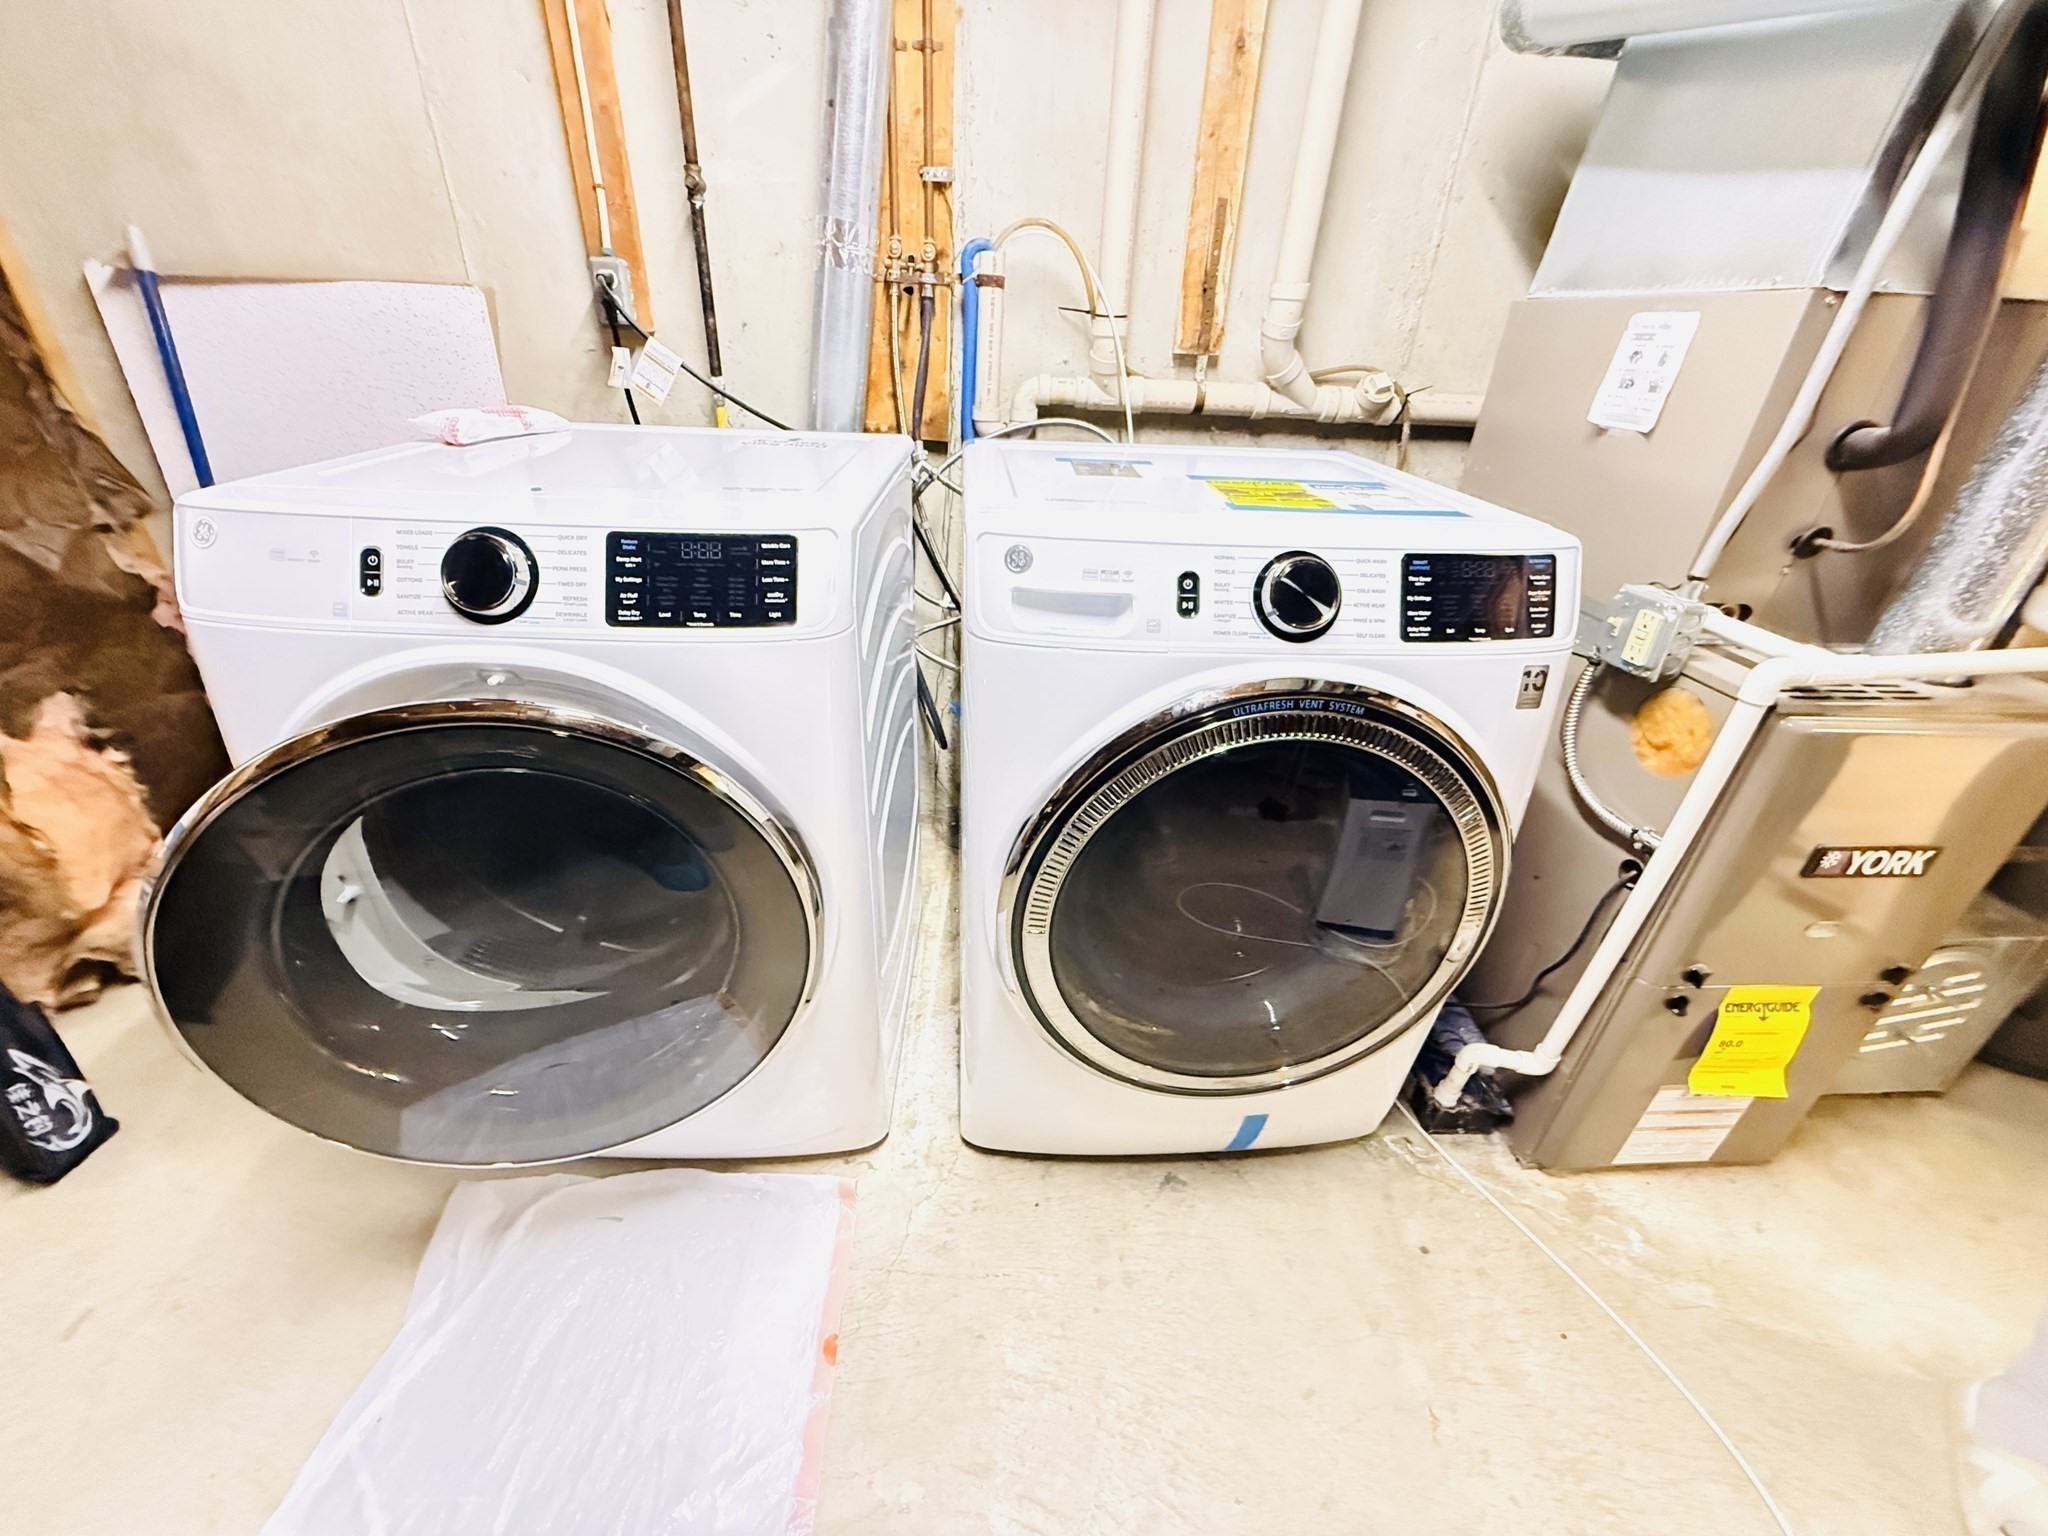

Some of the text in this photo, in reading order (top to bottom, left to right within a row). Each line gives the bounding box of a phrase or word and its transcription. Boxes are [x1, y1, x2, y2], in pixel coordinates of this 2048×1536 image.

[1523, 670, 1548, 692] 10
[1232, 699, 1365, 717] ULTRAFRESH VENT SYSTEM
[1845, 850, 1936, 875] YORK
